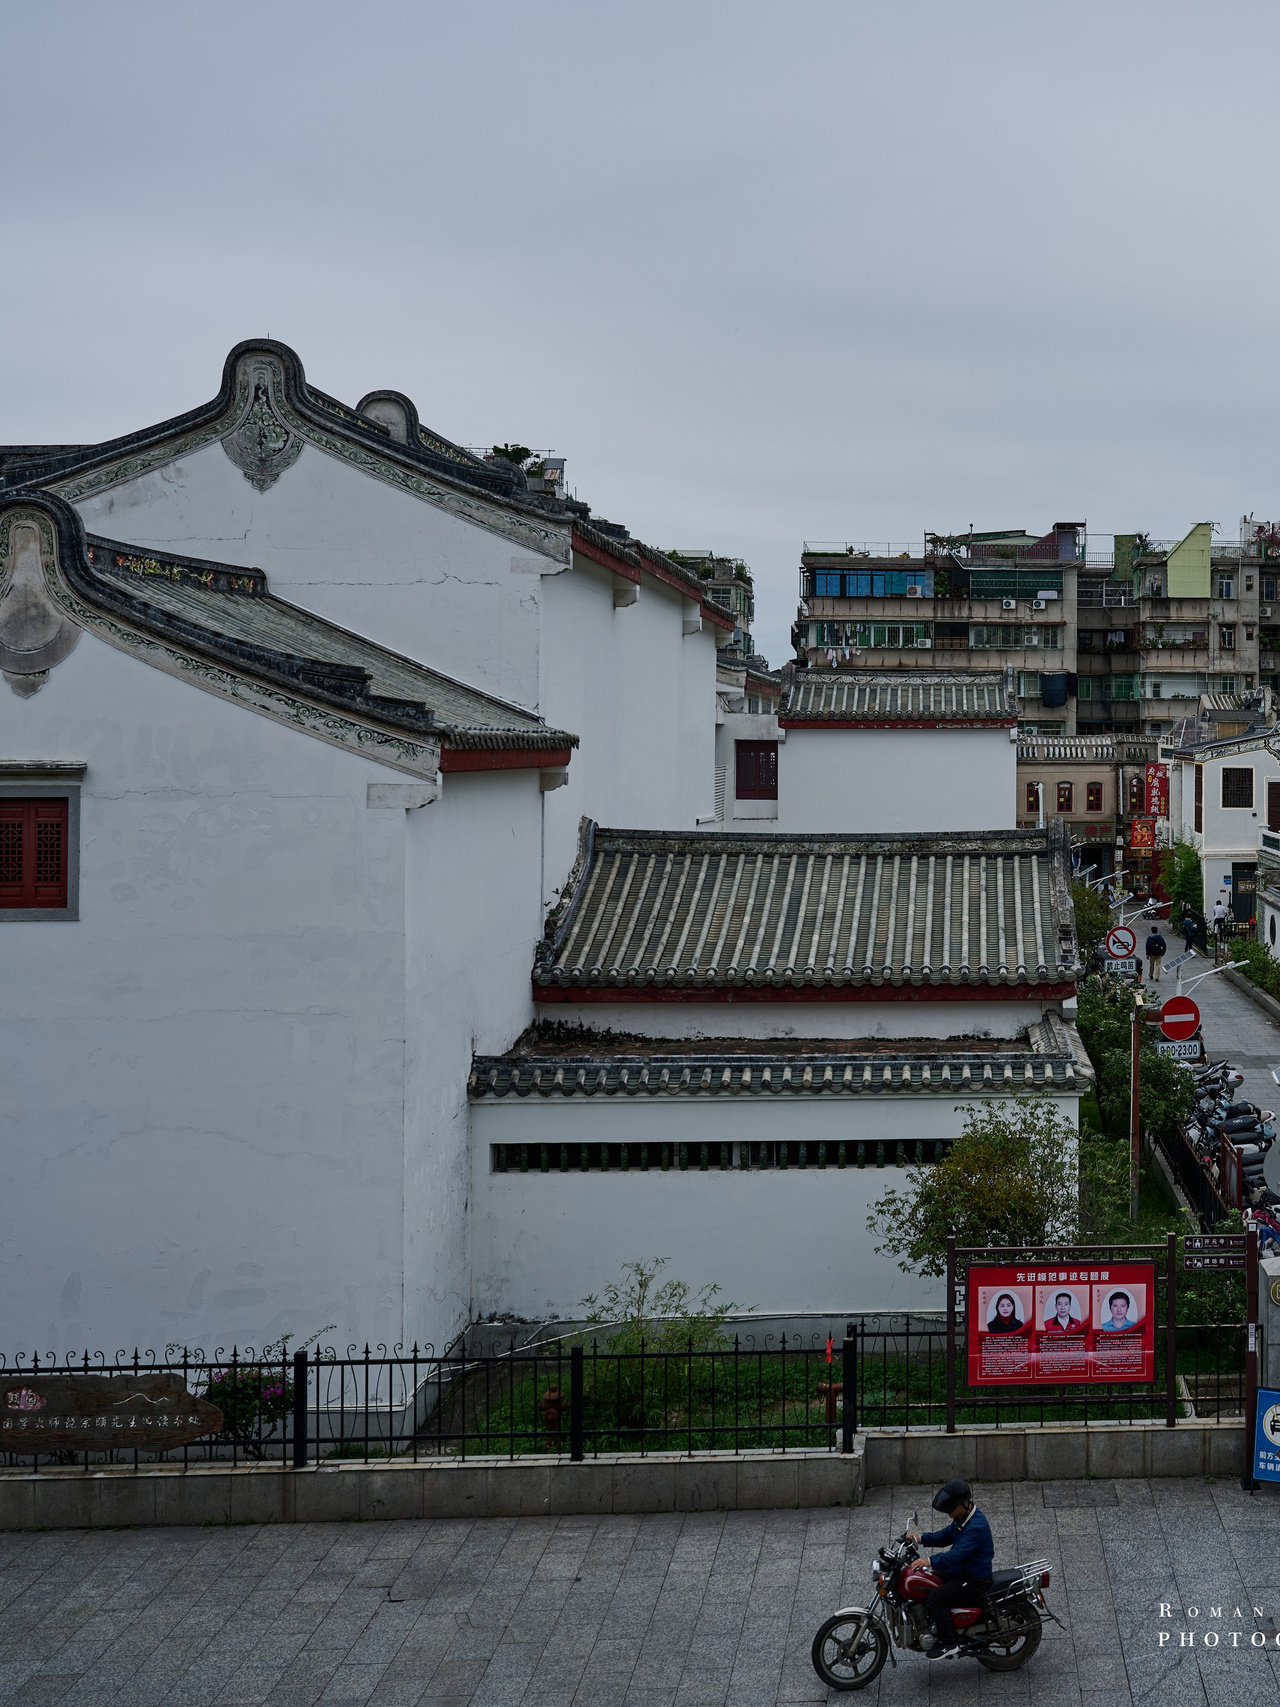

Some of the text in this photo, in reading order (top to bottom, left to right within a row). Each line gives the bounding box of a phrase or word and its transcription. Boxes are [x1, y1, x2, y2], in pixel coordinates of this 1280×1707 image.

[1107, 961, 1134, 970] 禁止鸣笛
[1016, 1271, 1110, 1282] 先进模范事迹专题展
